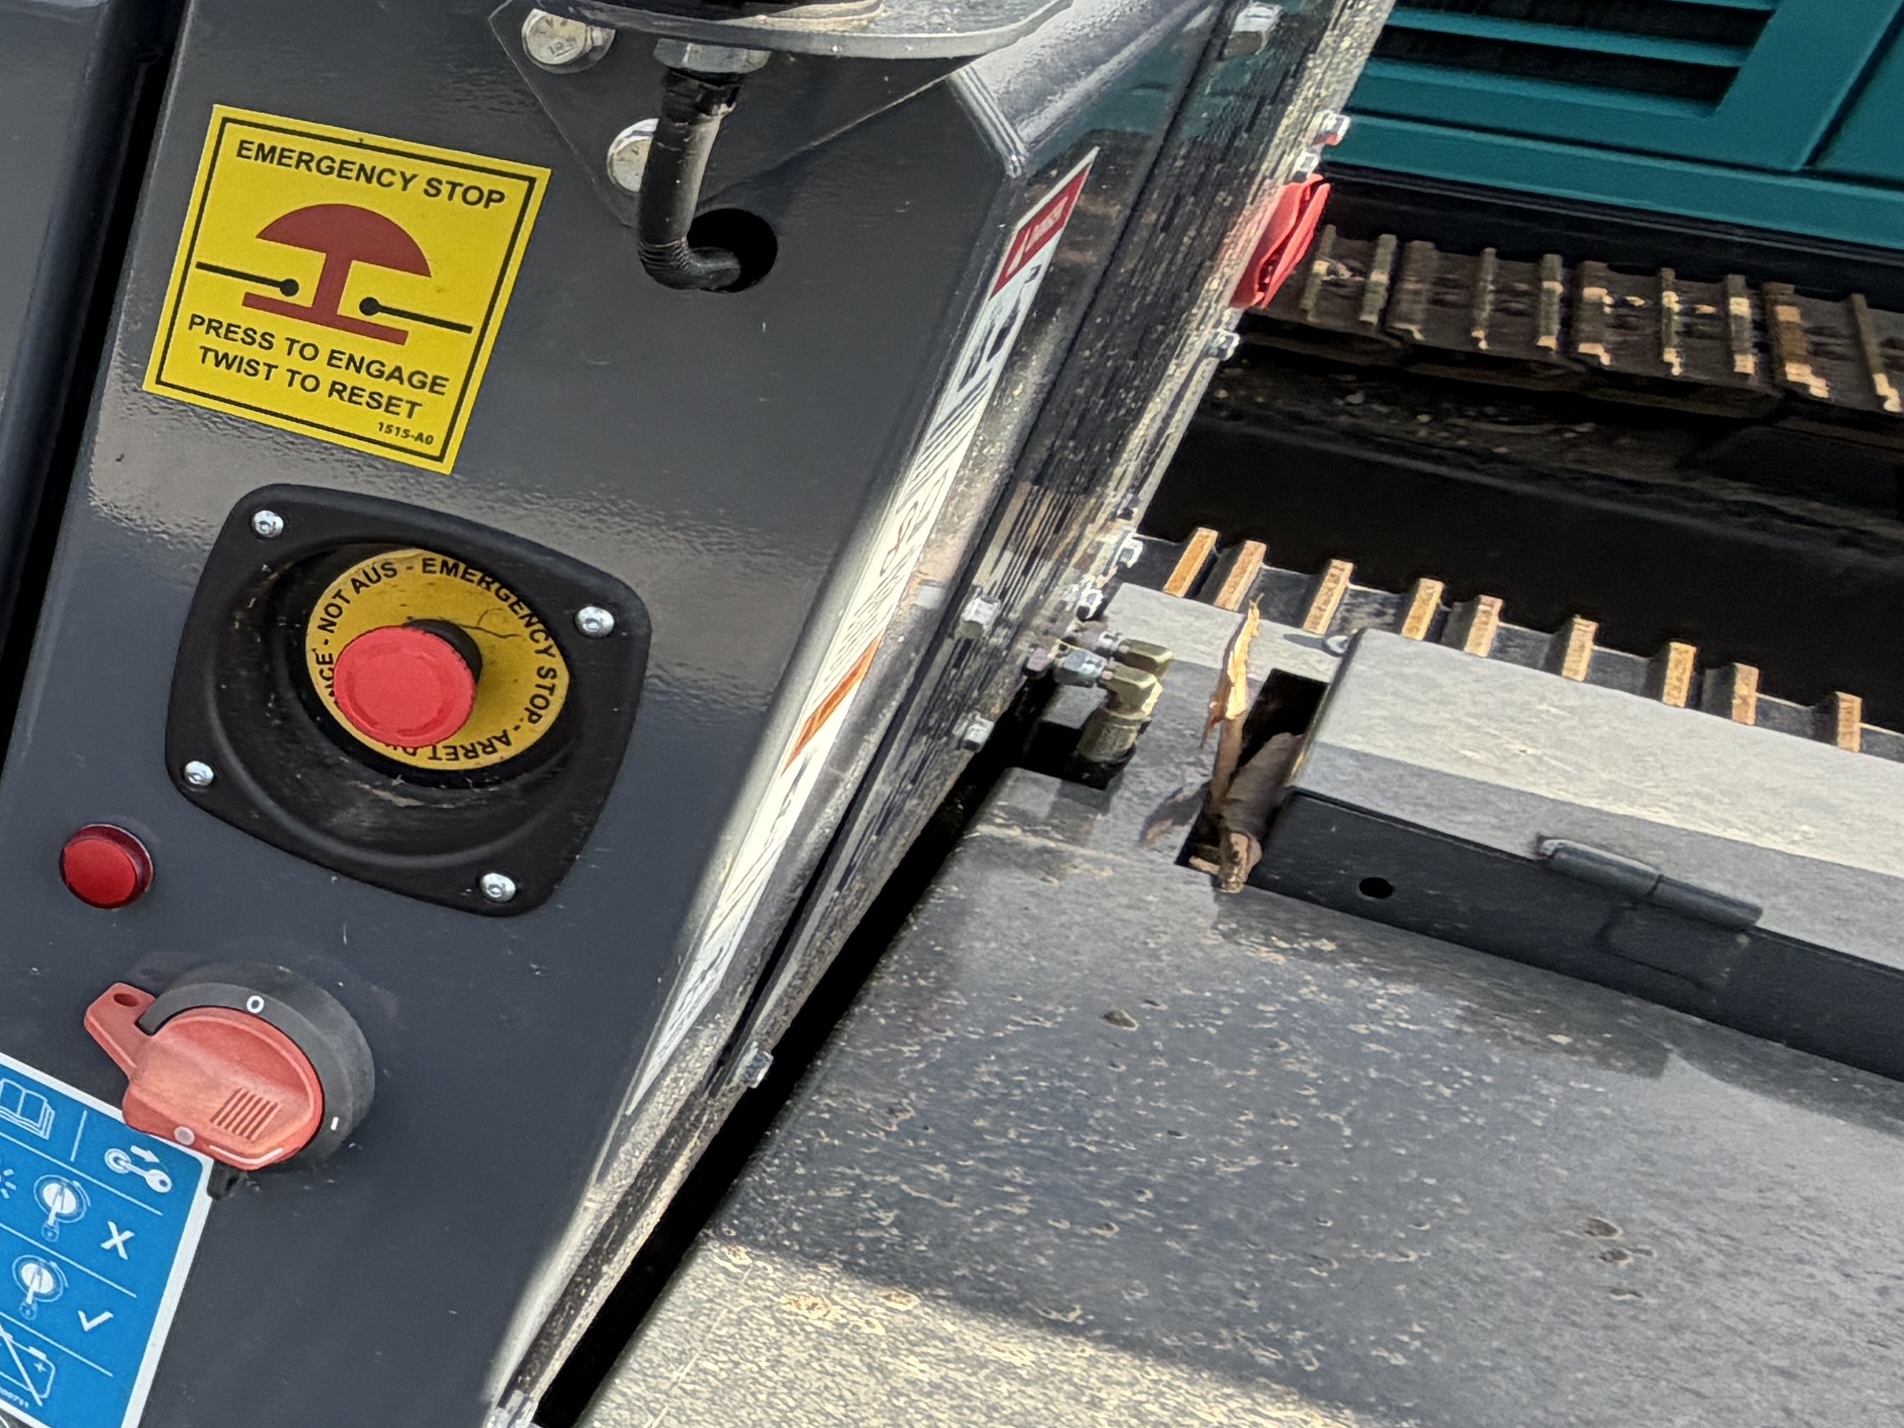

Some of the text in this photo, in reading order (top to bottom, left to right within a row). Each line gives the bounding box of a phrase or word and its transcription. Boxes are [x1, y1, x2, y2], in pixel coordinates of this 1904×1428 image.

[236, 139, 506, 210] EMERGENCY STOP
[188, 313, 450, 396] PRESS TO ENGAGE
[198, 346, 423, 420] TWIST TO RESET
[351, 562, 397, 594] AUS
[422, 558, 556, 658] EMERGENCY
[317, 589, 350, 633] NOT
[524, 666, 557, 724] STOP
[428, 729, 512, 761] ARRET
